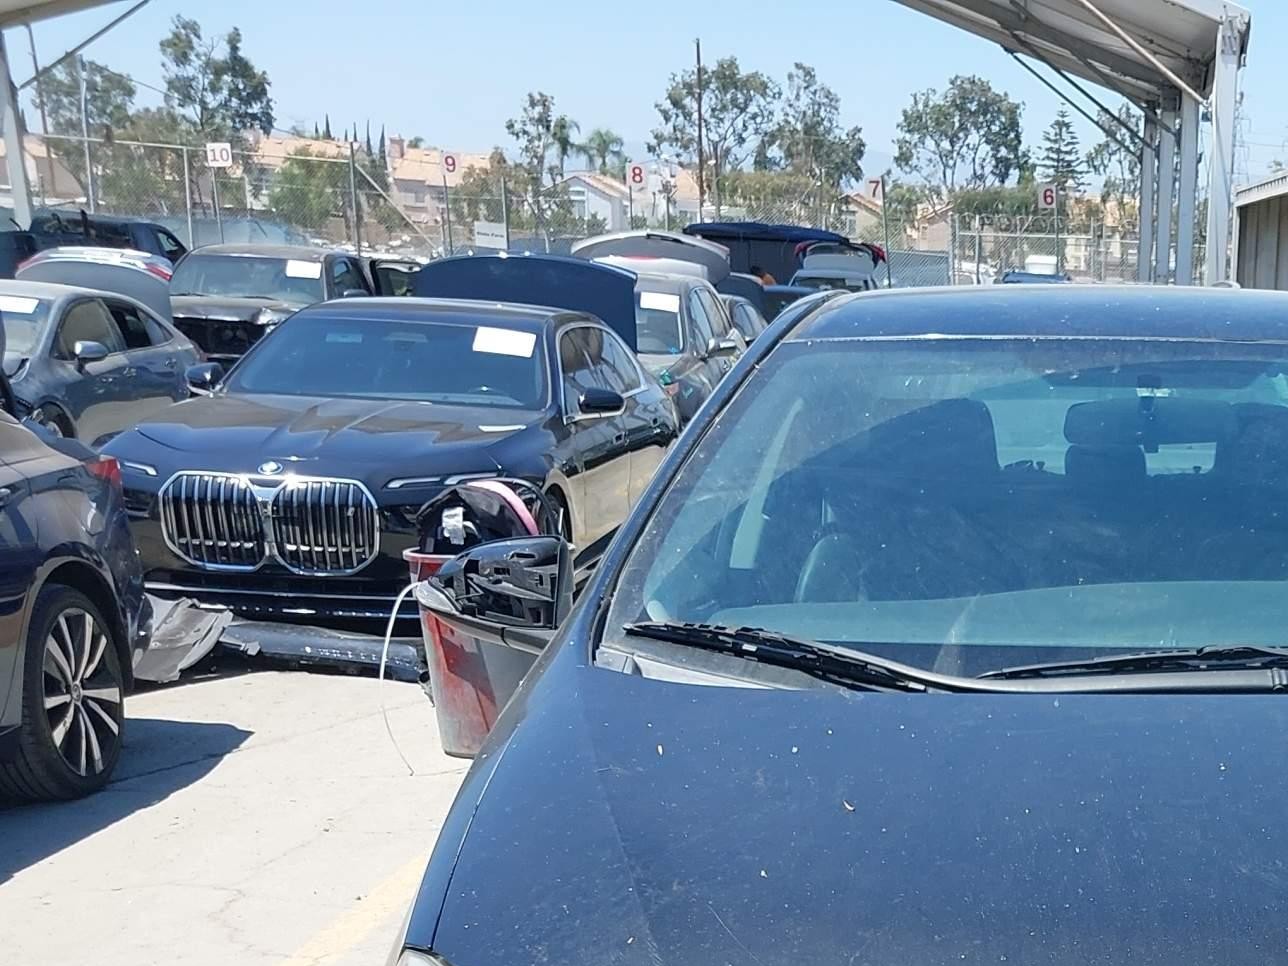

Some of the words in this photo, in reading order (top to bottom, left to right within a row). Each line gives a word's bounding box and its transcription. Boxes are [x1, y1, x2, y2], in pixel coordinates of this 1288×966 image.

[210, 148, 230, 162] 10
[444, 155, 456, 173] 9
[632, 166, 643, 183] 8
[868, 180, 880, 198] 7
[1043, 188, 1054, 205] 6
